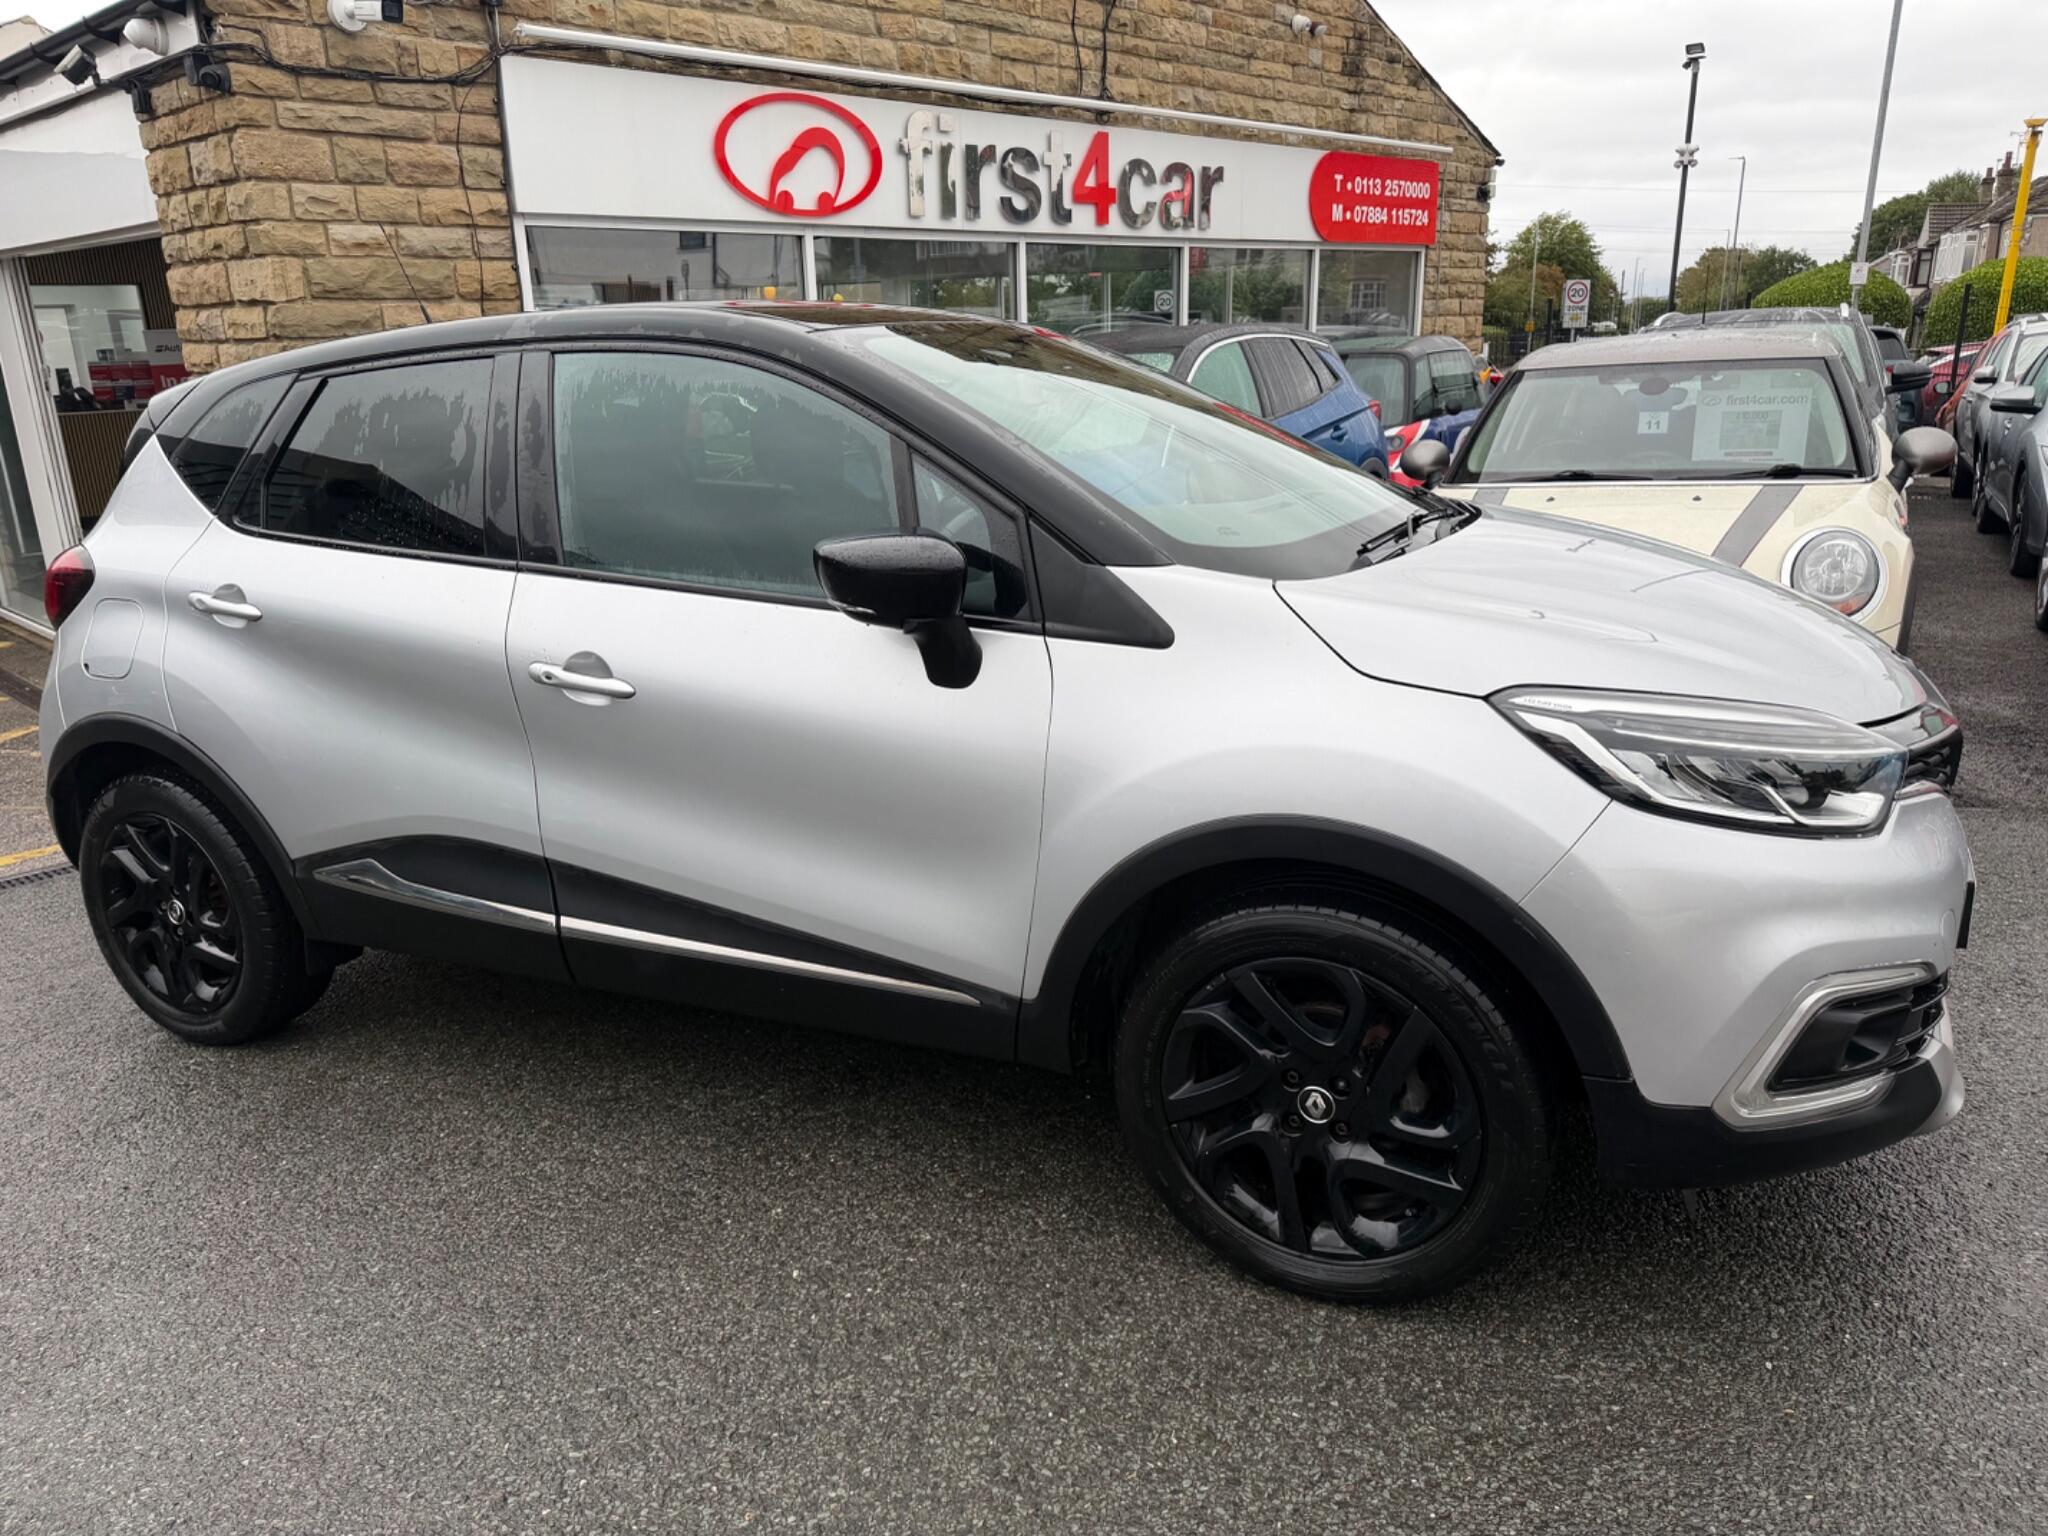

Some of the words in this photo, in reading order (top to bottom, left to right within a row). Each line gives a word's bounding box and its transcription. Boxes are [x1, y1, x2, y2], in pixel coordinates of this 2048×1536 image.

[898, 110, 1224, 231] first4car
[1334, 174, 1343, 192] T
[1354, 176, 1382, 196] 0113
[1384, 179, 1431, 199] 2570000
[1331, 203, 1343, 222] M
[1353, 205, 1388, 225] 07884
[1391, 208, 1428, 226] 115724
[1571, 287, 1585, 298] 20
[1159, 297, 1171, 306] 20
[1726, 394, 1808, 406] first4car.com
[1645, 420, 1660, 430] 11
